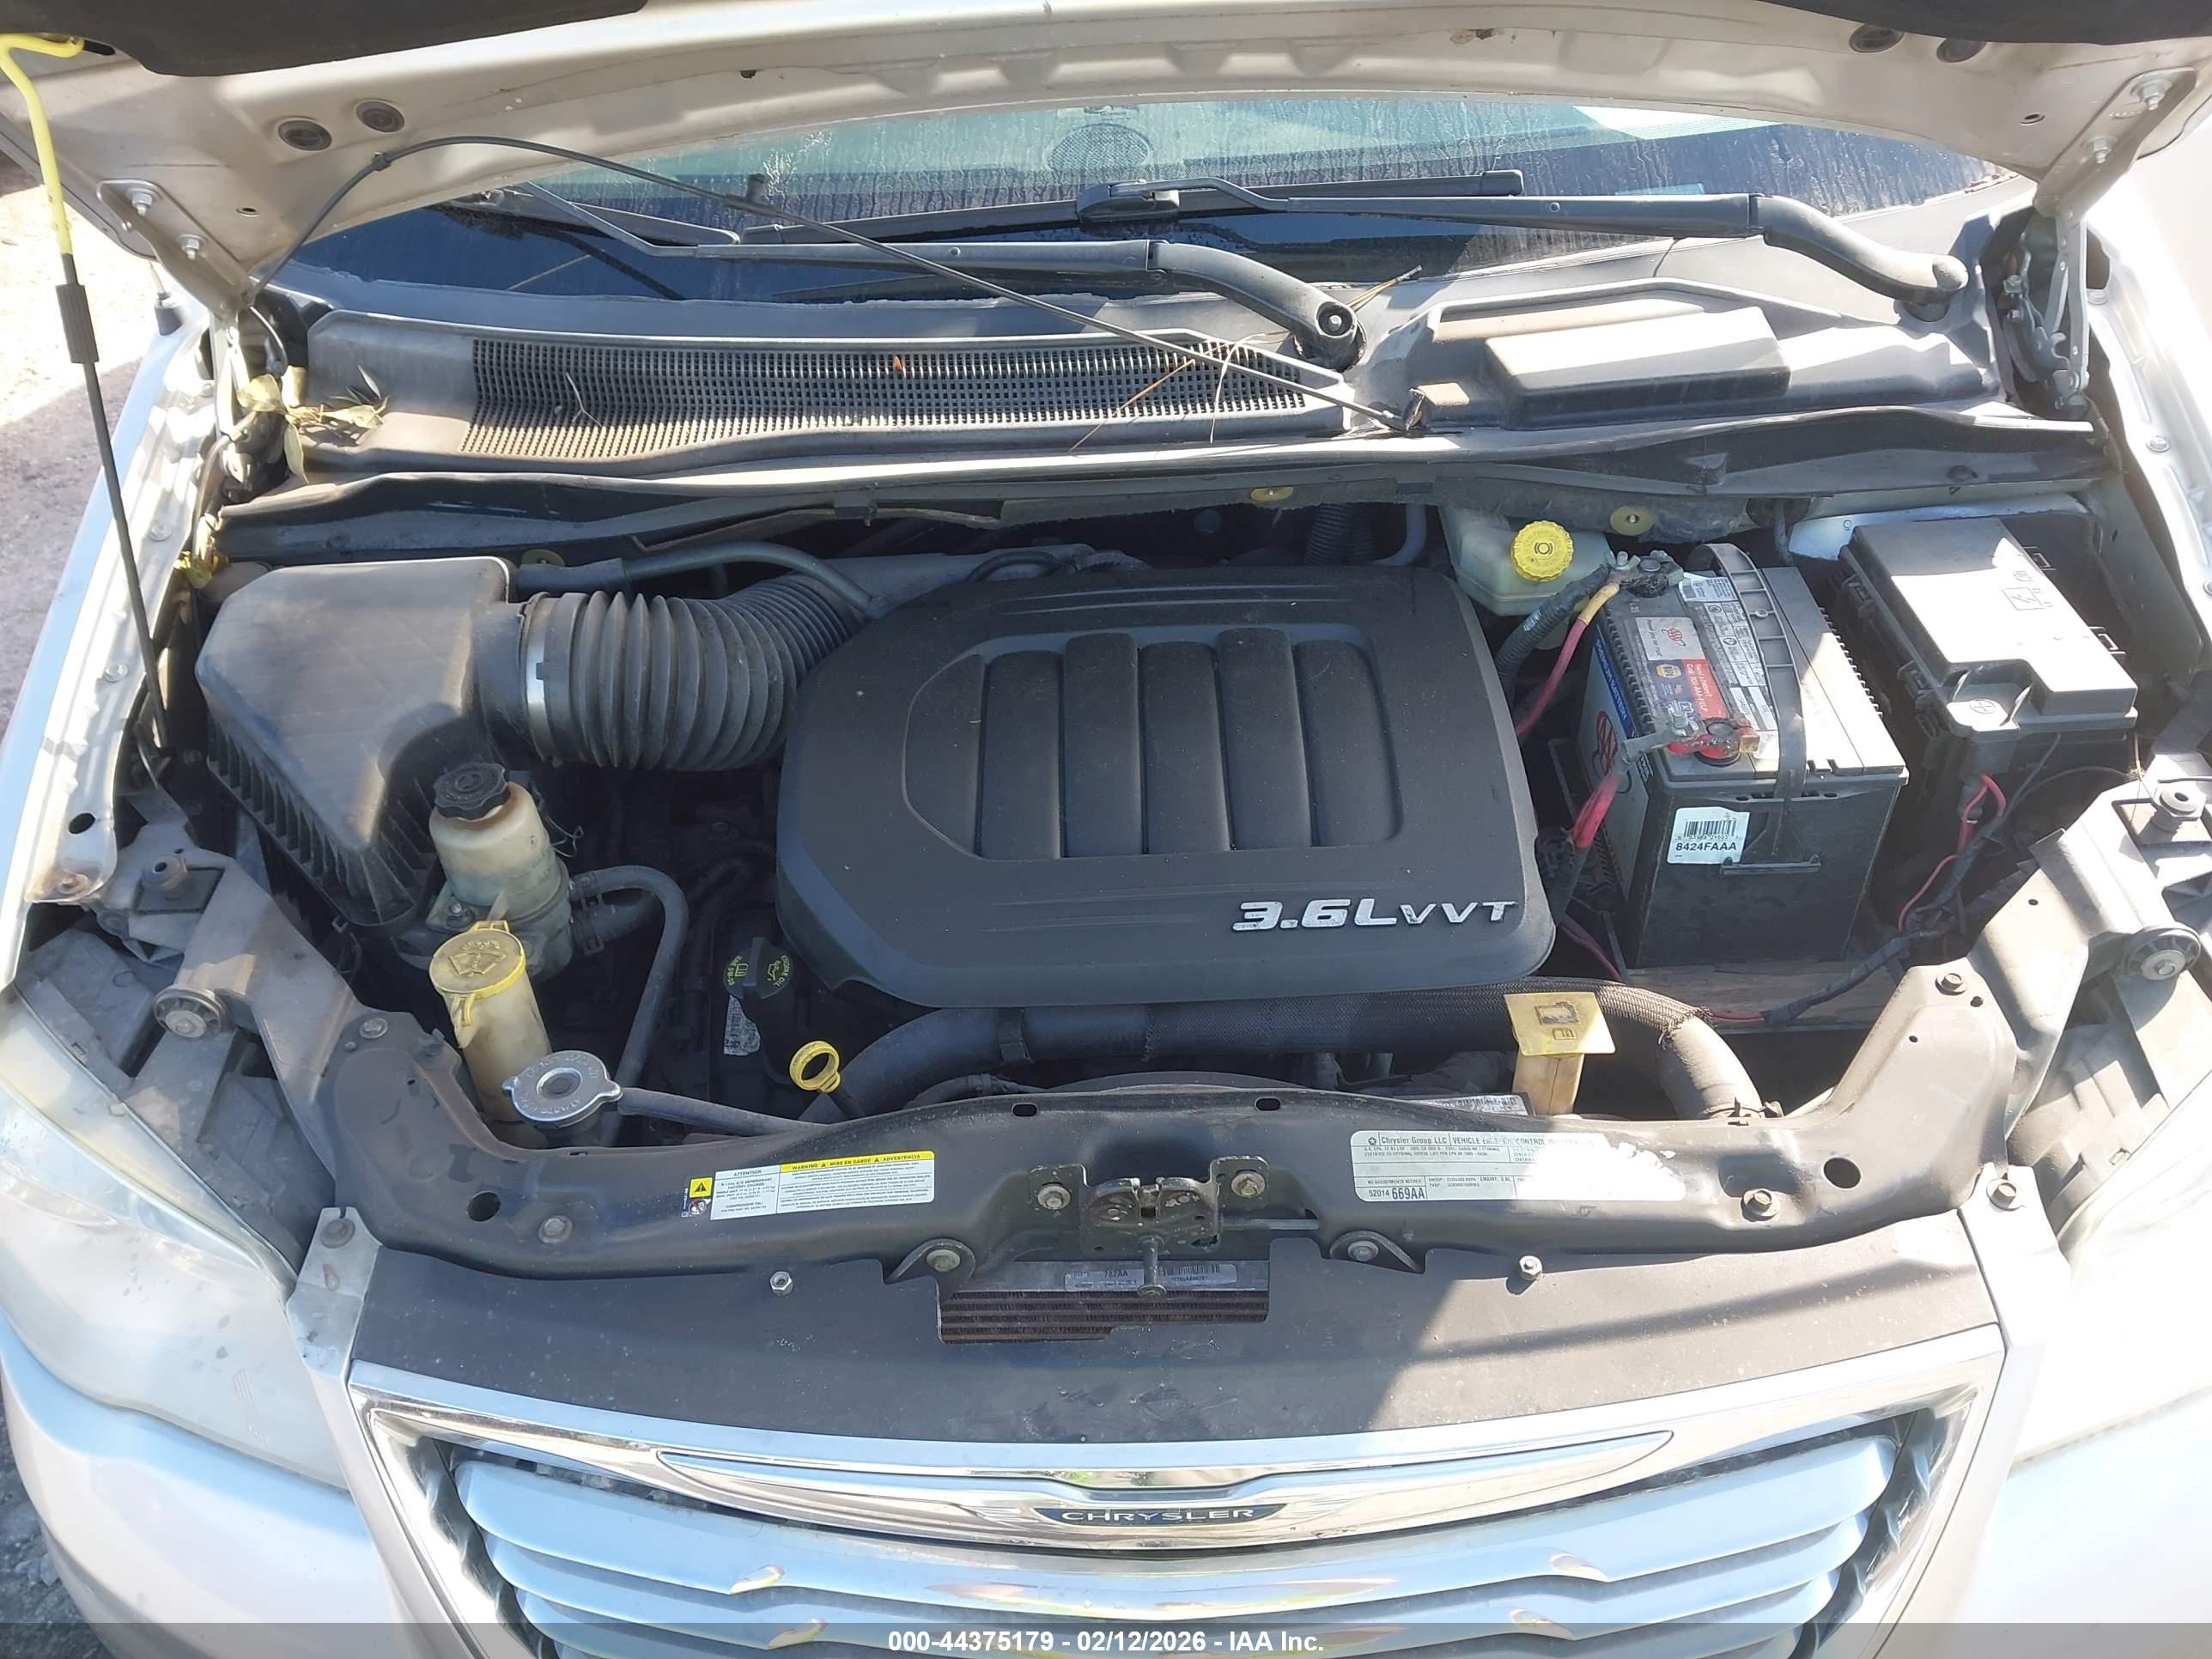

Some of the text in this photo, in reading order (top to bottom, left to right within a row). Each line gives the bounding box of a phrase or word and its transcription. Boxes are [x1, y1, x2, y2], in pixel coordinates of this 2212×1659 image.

[1675, 842, 1736, 851] 8424FAAA
[1381, 1137, 1409, 1146] Chrysler
[1411, 1137, 1432, 1146] Group
[1392, 1188, 1425, 1200] 669AA
[1061, 1508, 1255, 1522] CHRYSLER
